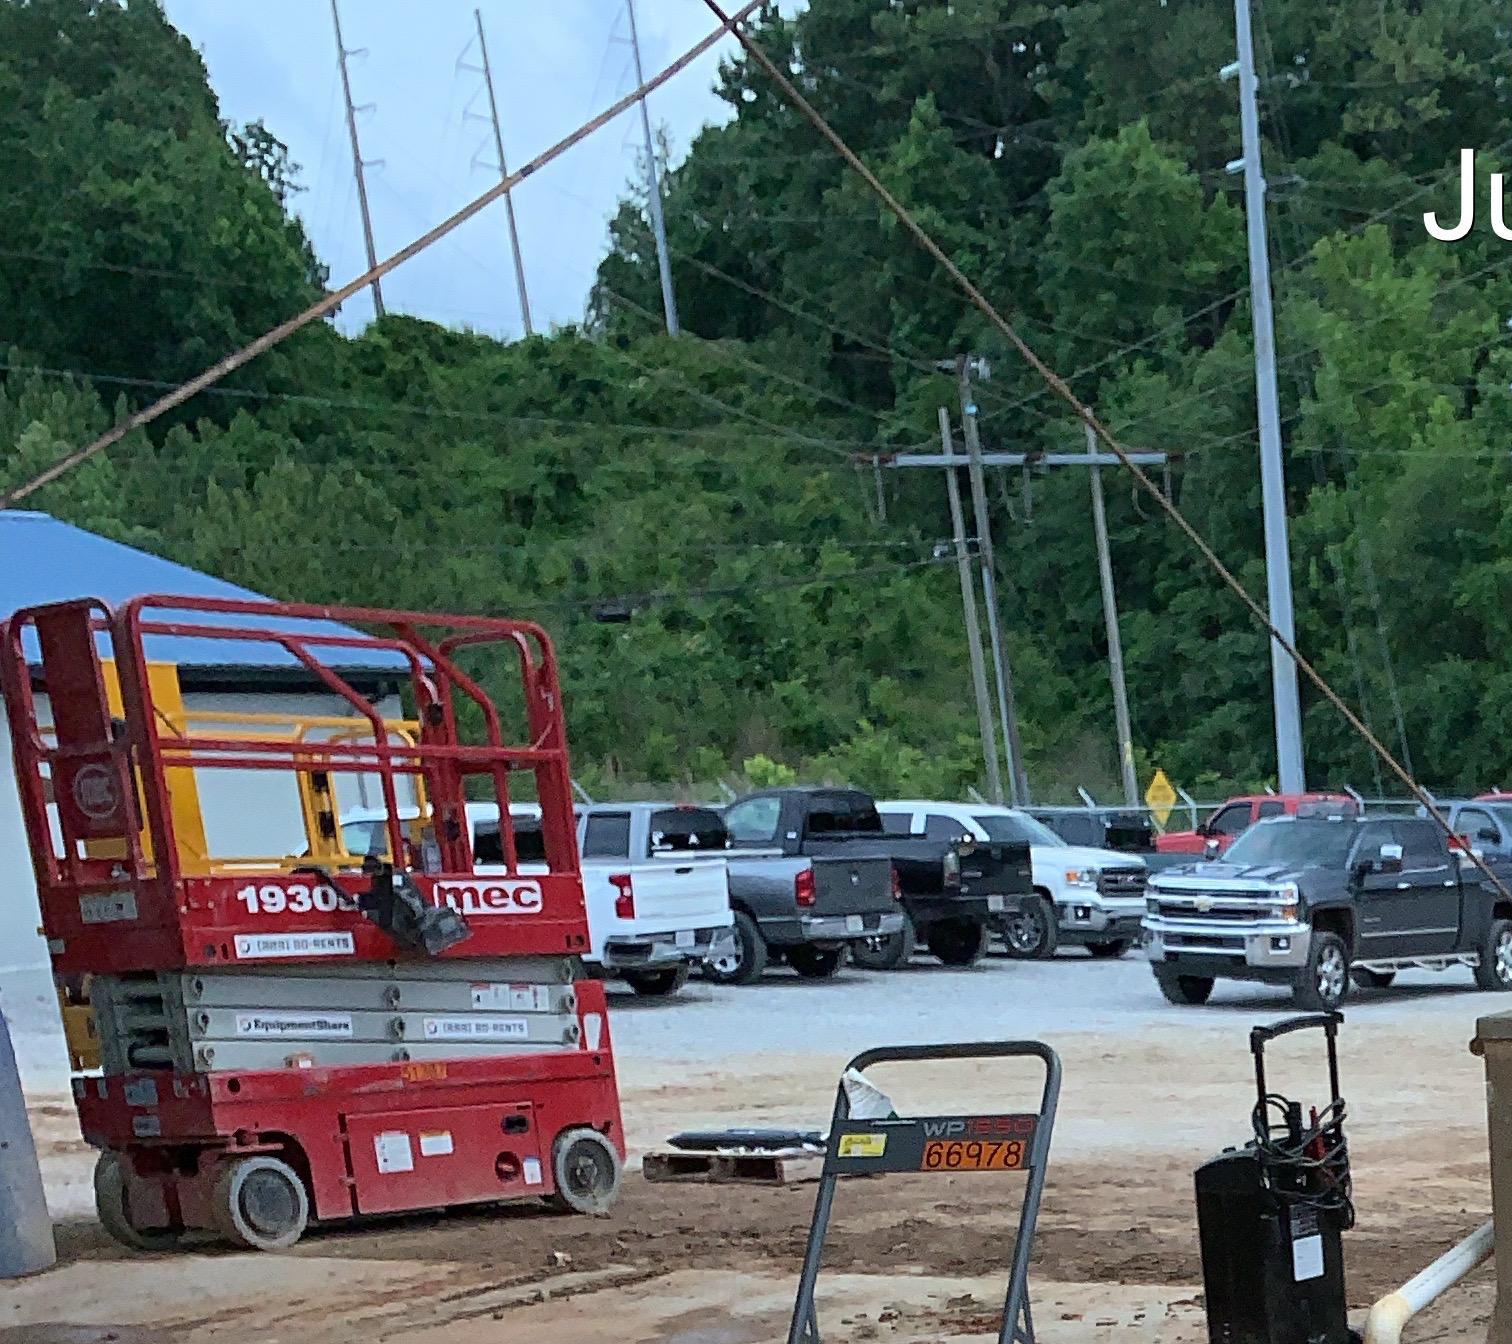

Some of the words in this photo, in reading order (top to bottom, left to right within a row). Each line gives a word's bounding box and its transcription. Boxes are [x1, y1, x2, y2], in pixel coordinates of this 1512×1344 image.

[436, 884, 539, 909] mec
[253, 1018, 350, 1034] EquipmentShare
[926, 1141, 1022, 1168] 66978
